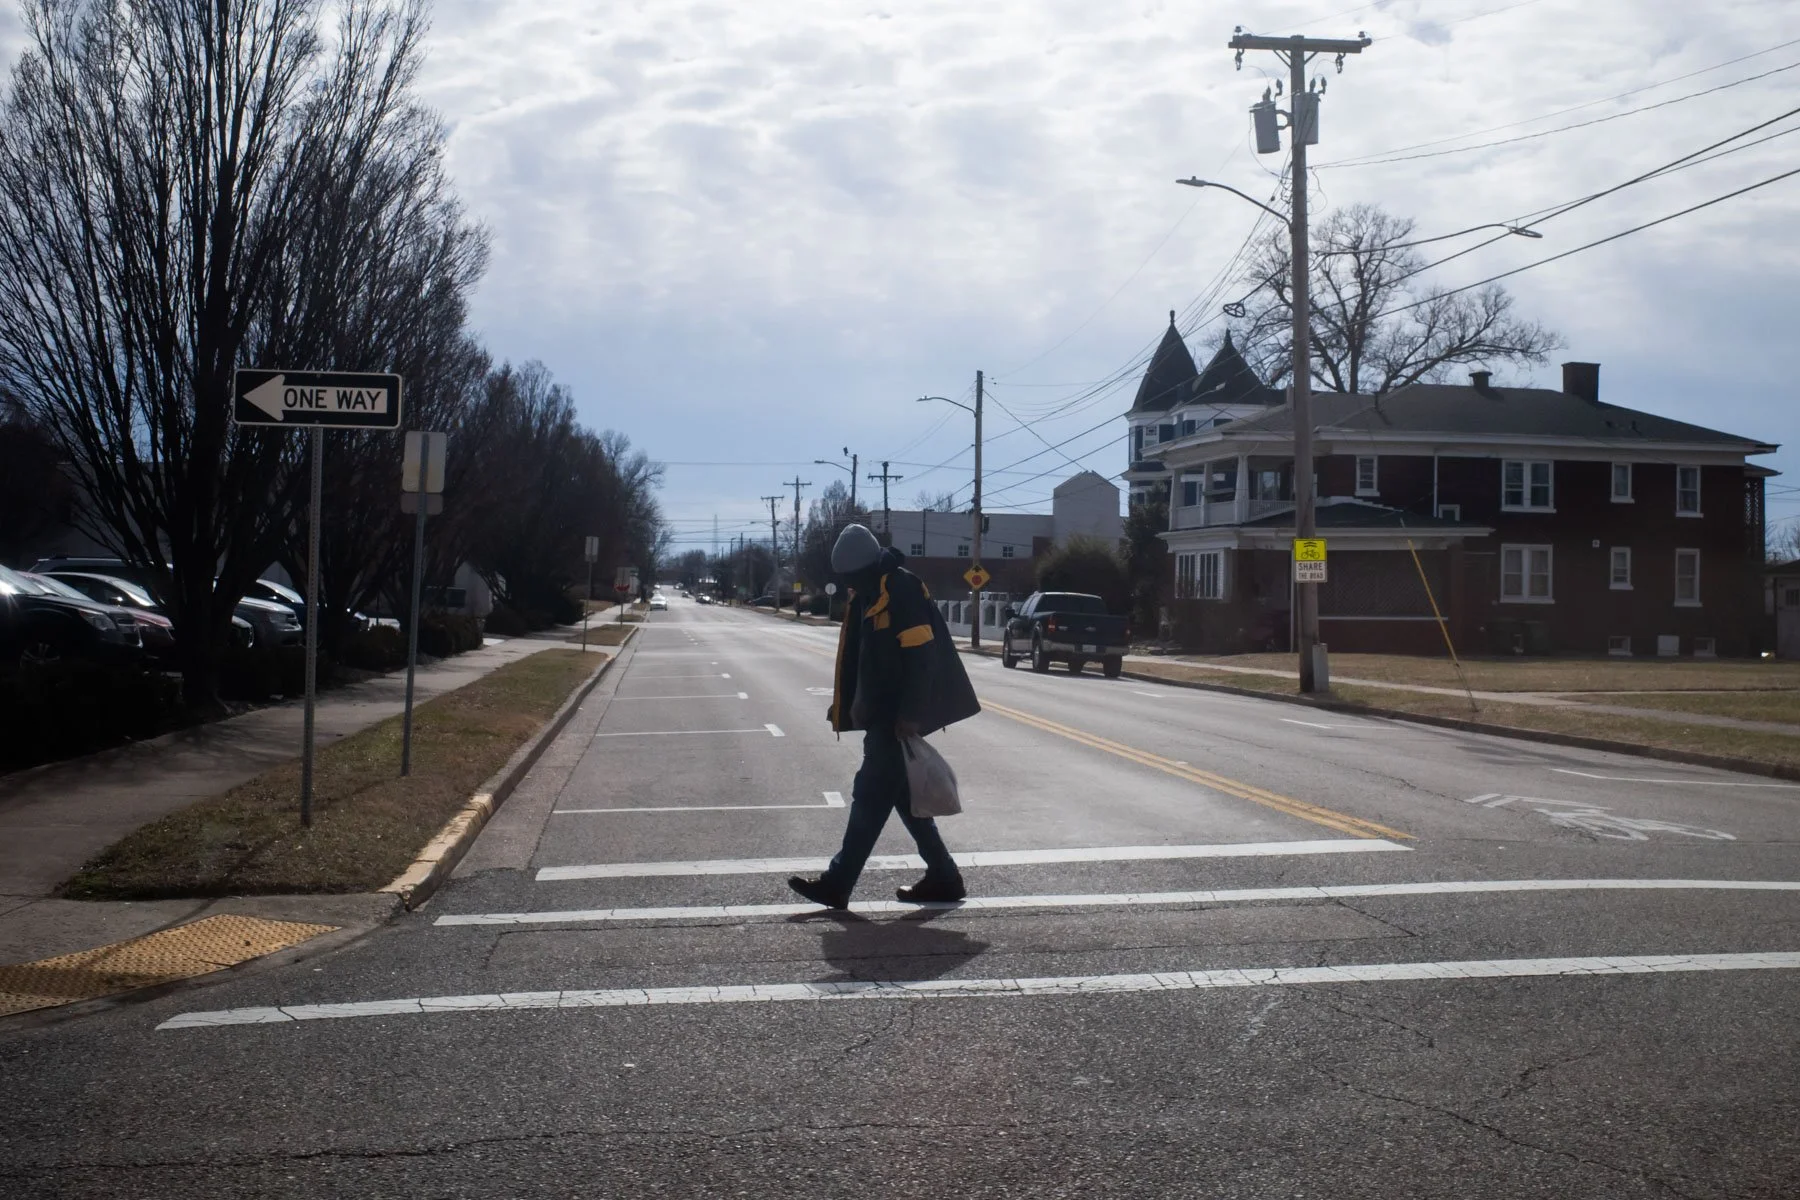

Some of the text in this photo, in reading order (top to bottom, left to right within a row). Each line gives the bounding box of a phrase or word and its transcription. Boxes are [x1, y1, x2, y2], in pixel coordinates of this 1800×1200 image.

[284, 388, 381, 411] ONE WAY
[1298, 562, 1323, 571] SHARE
